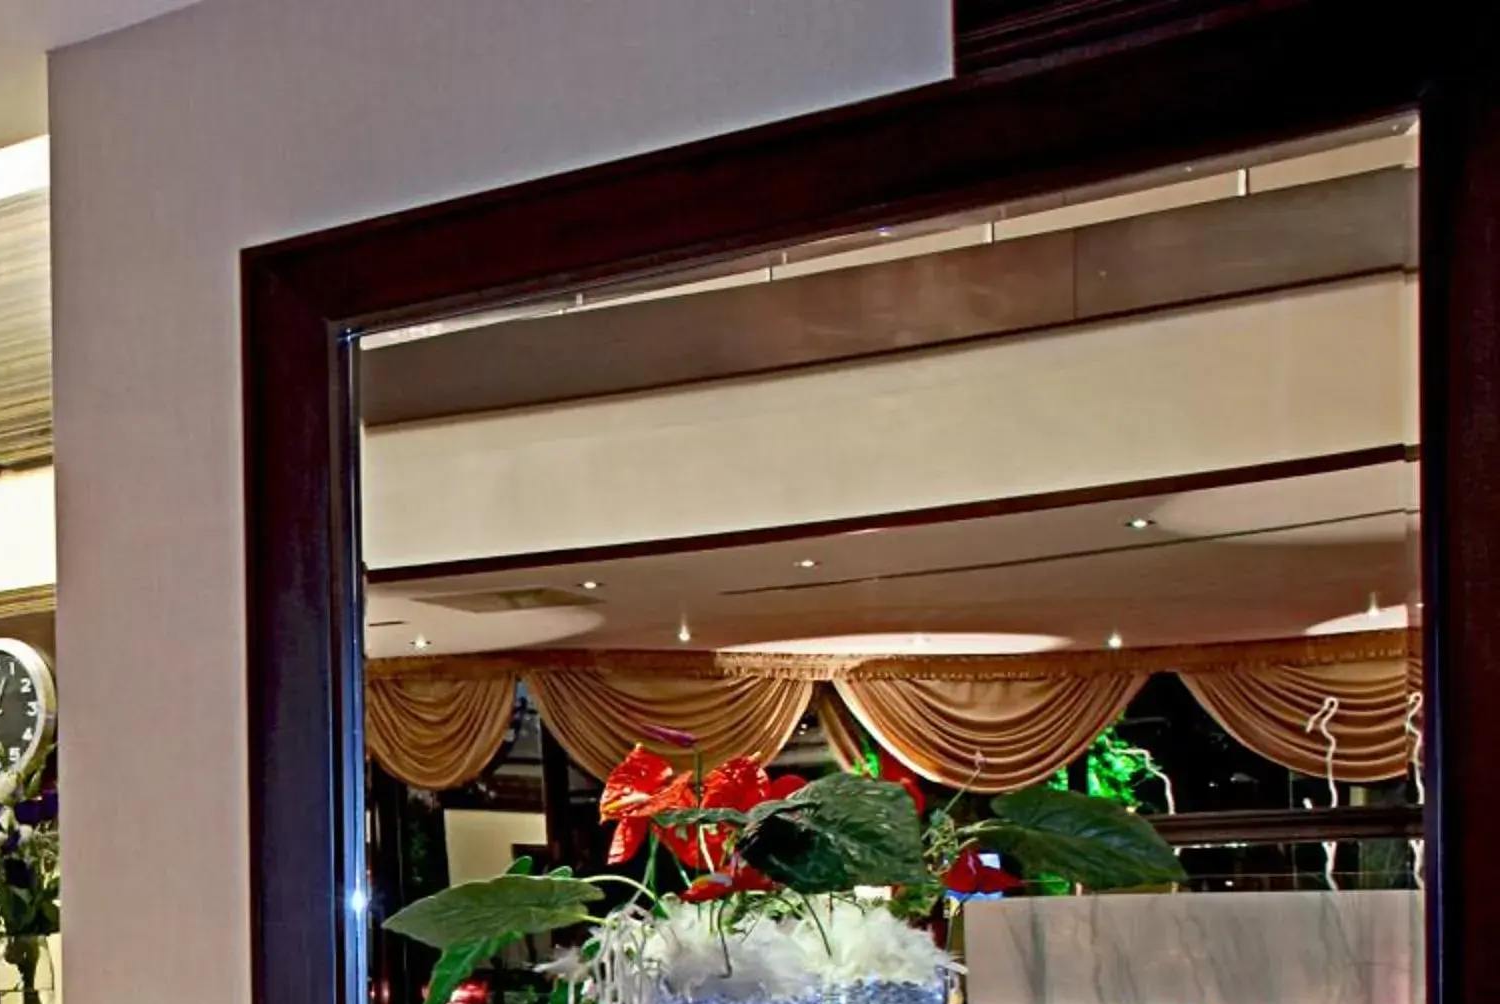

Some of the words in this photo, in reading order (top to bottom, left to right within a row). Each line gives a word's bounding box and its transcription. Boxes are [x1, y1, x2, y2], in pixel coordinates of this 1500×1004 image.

[21, 678, 32, 693] 2
[26, 701, 37, 716] 3
[22, 727, 33, 740] 4
[9, 747, 20, 760] 5
